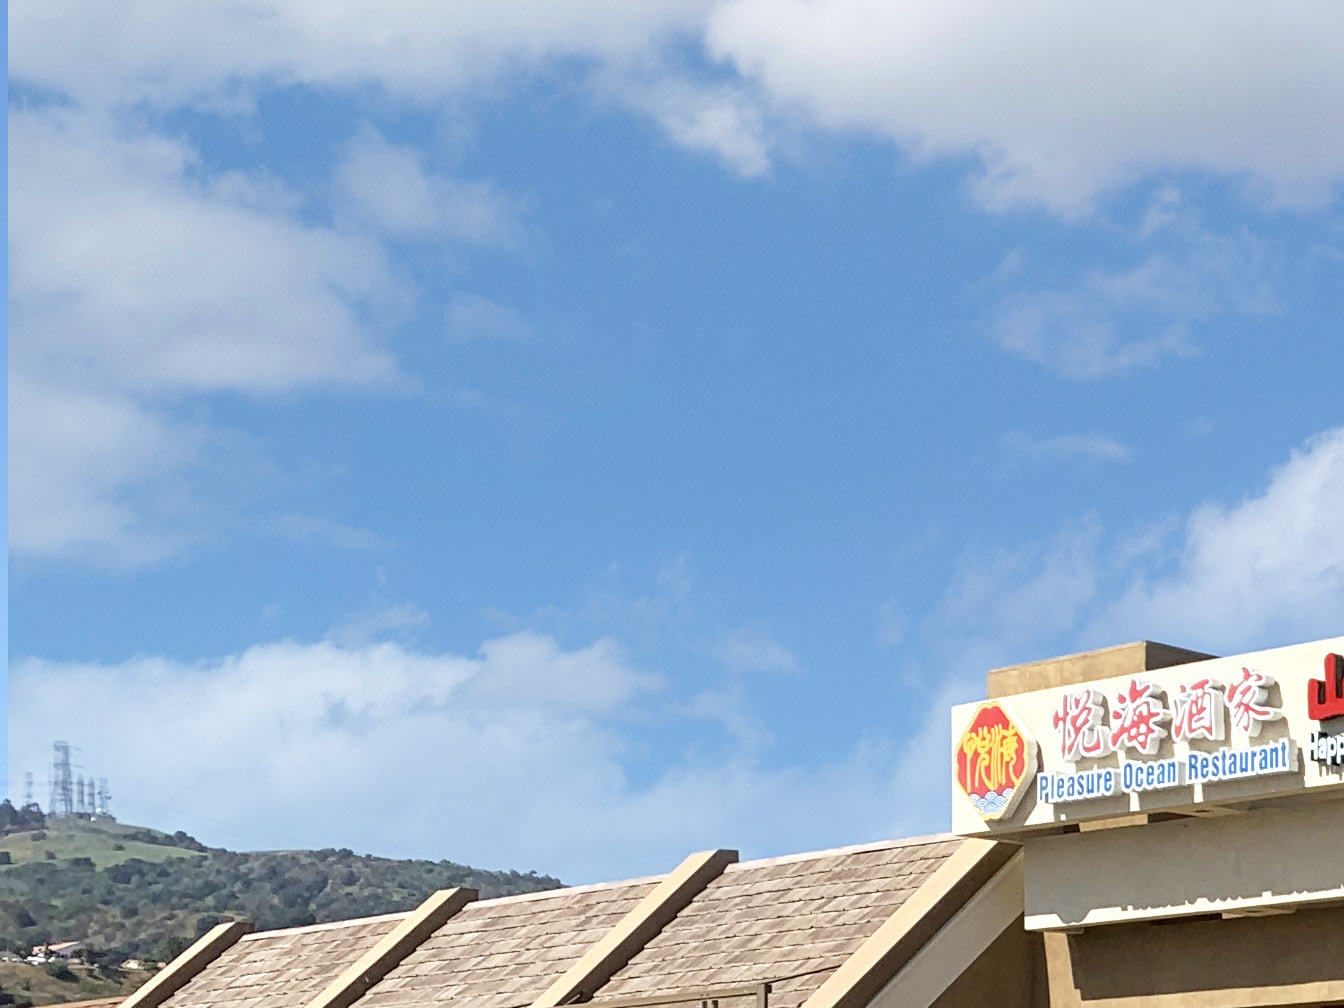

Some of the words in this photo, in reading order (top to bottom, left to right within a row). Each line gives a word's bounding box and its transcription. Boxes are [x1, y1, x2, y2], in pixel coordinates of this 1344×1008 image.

[1039, 771, 1113, 802] Pleasure
[1122, 759, 1177, 790] Ocean
[1187, 741, 1288, 782] Restaurant
